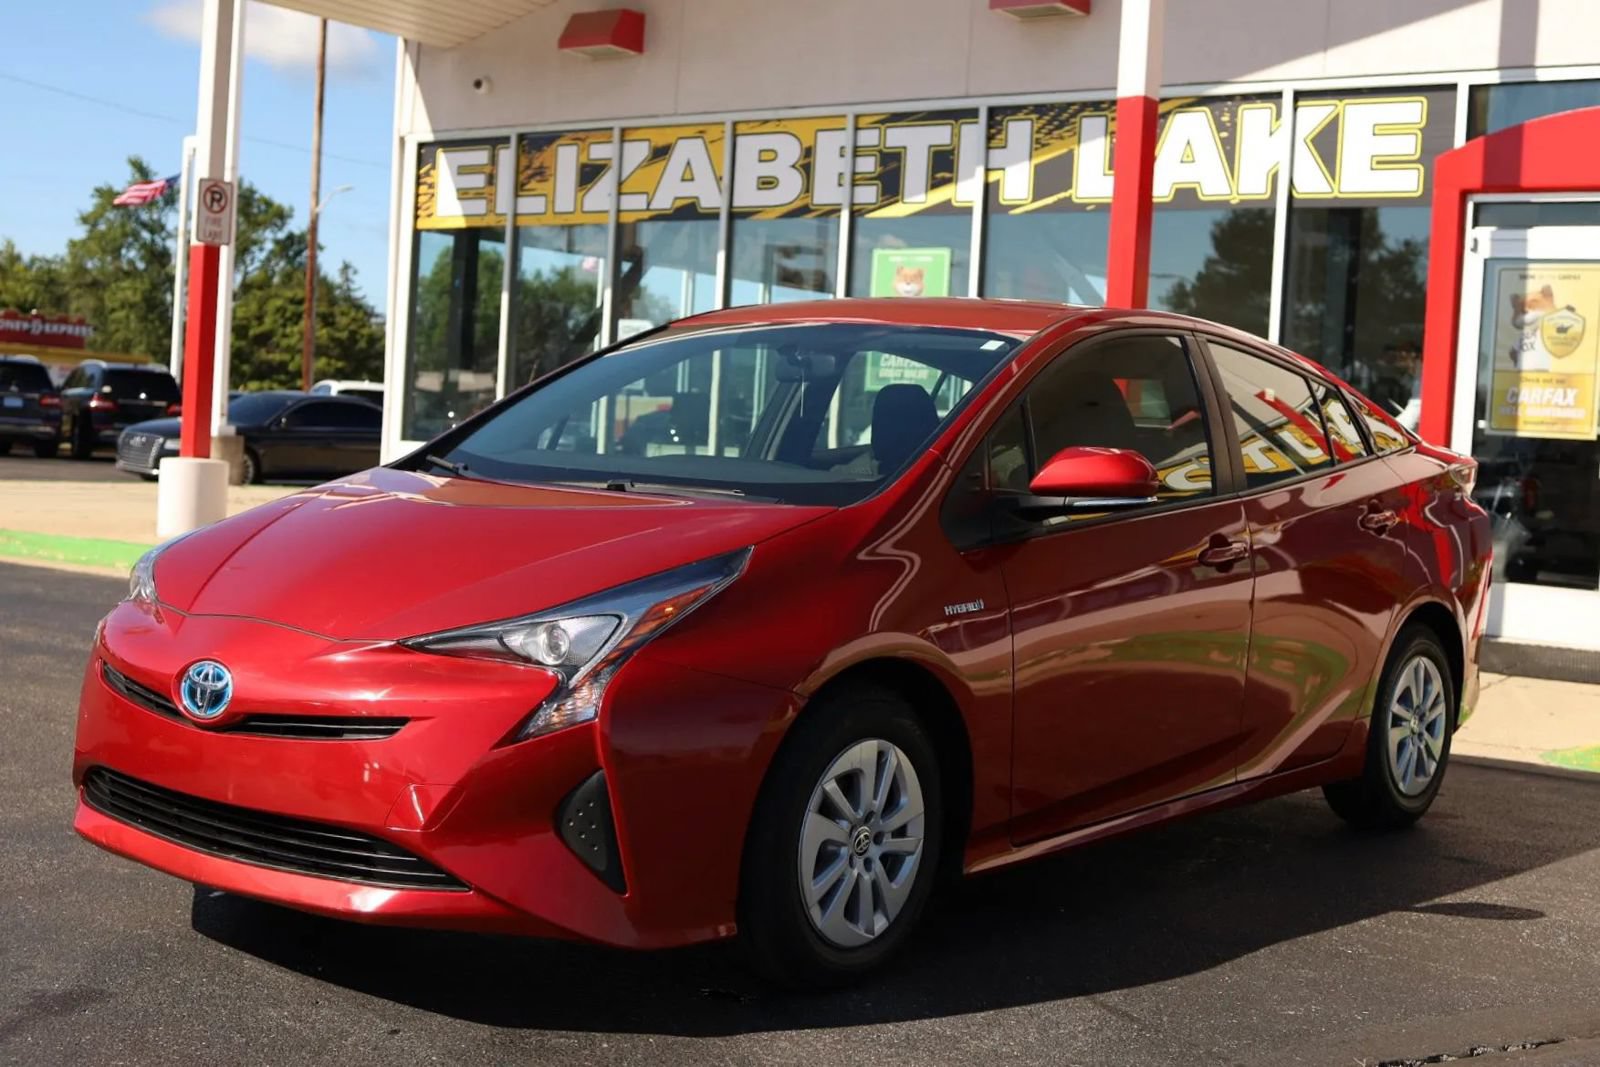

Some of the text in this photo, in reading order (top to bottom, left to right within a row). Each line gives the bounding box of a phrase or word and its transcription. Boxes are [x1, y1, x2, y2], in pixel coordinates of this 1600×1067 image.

[435, 98, 1426, 217] ELIZABETH LAKE
[1507, 386, 1578, 406] CARFAX
